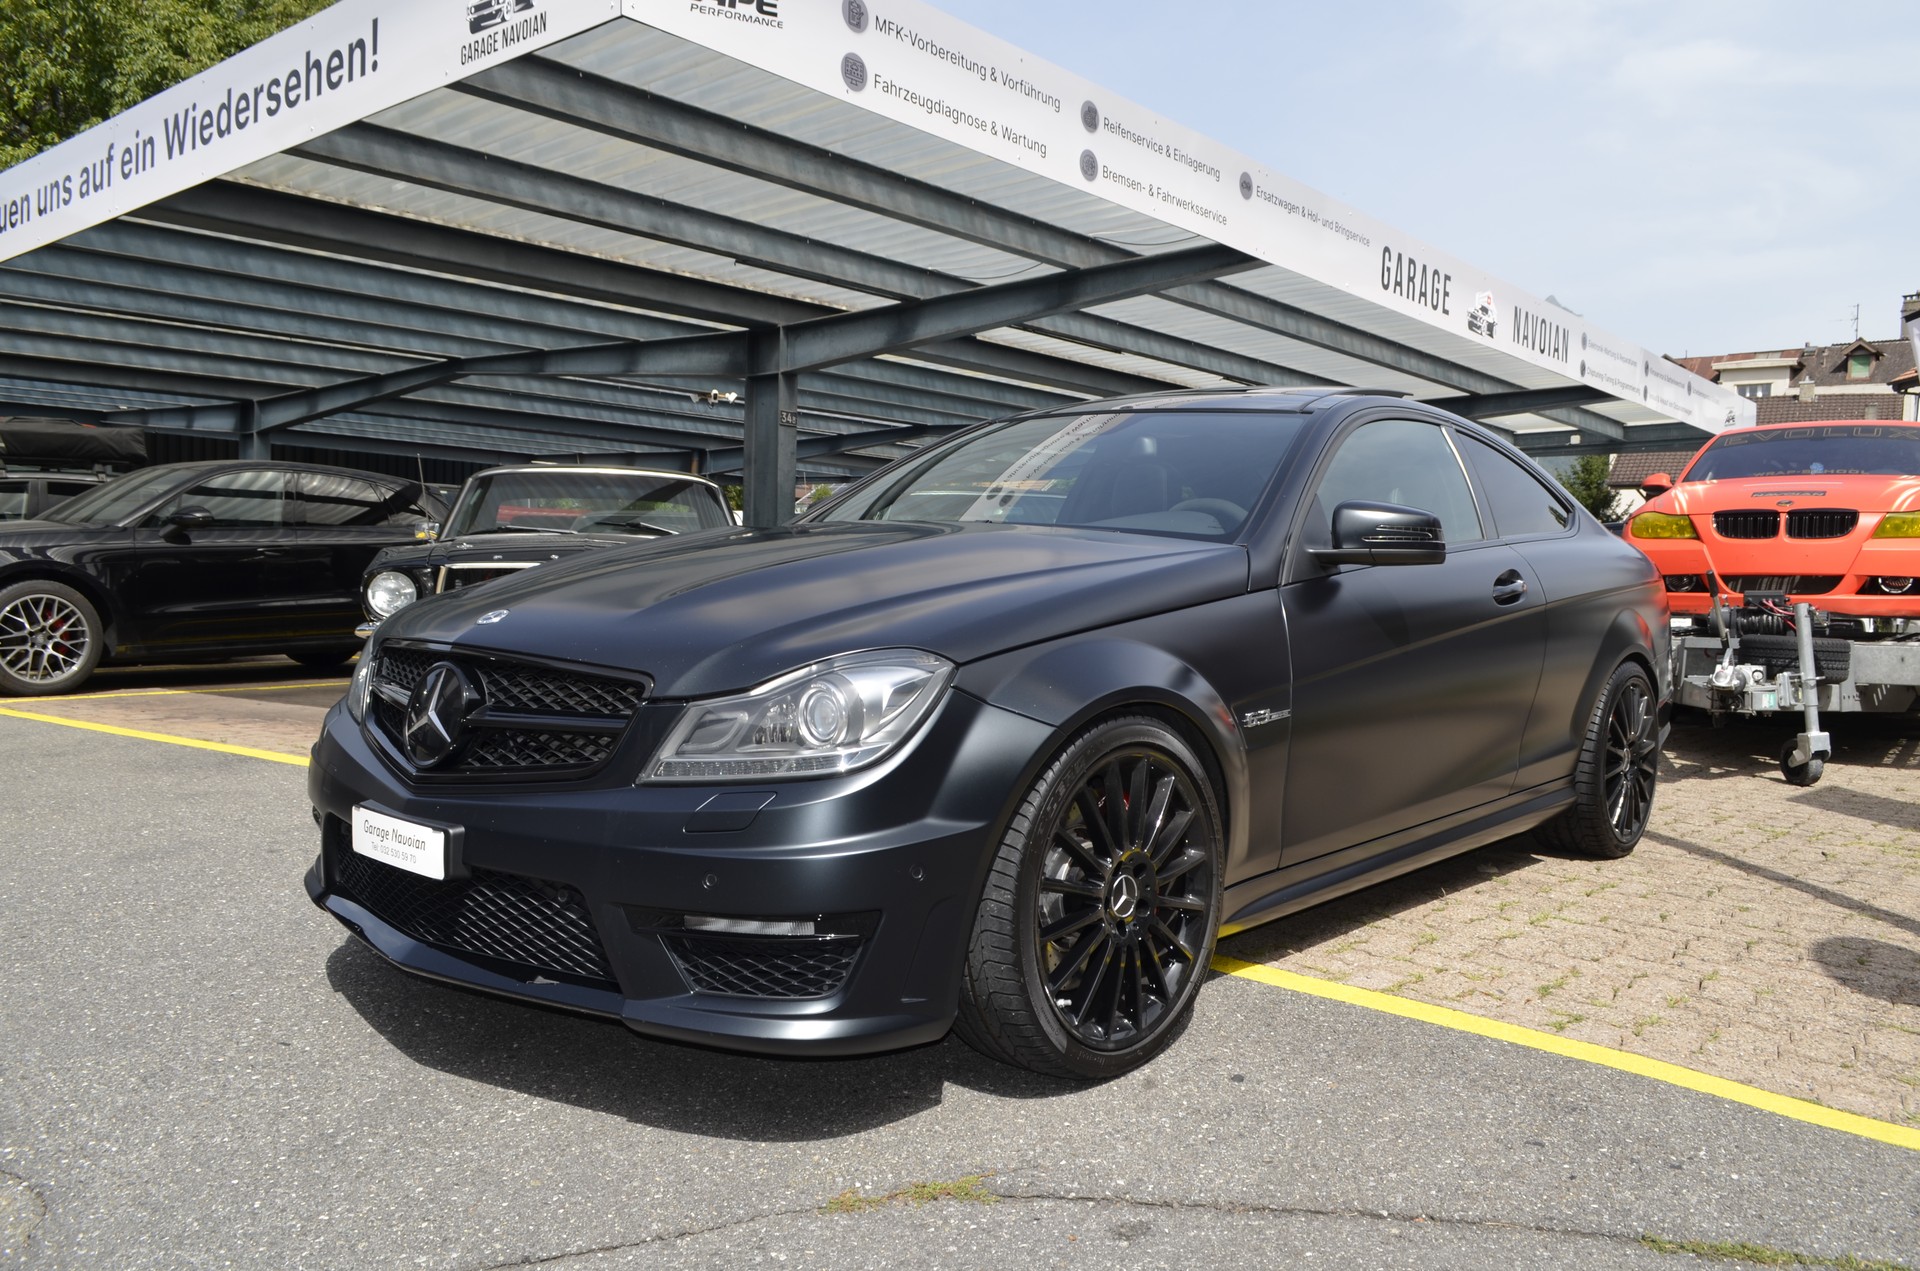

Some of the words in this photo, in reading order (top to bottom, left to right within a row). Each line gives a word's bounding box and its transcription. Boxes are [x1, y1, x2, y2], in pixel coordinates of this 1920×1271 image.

[460, 31, 499, 66] GARAGE
[501, 11, 547, 49] NAVOIAN
[689, 3, 784, 29] PERFORMANCE
[875, 15, 987, 81] MFK-Vorbereitung
[989, 66, 998, 82] &
[1001, 70, 1061, 113] Vorführung
[37, 174, 73, 217] uns
[79, 142, 115, 199] auf
[120, 129, 155, 180] ein
[163, 17, 379, 160] Wiedersehen!
[874, 73, 988, 132] Fahrzeugdiagnose
[990, 120, 998, 136] &
[1001, 124, 1047, 158] Wartung
[1103, 117, 1164, 155] Reifenservice
[1165, 145, 1171, 158] &
[1173, 148, 1220, 182] Einlagerung
[1102, 165, 1146, 192] Bremsen-
[1148, 184, 1154, 197] &
[1156, 187, 1227, 226] Fahrwerksservice
[1256, 185, 1300, 215] Ersatzwagen
[1301, 206, 1306, 218] &
[1307, 208, 1321, 224] Hol-
[1322, 217, 1334, 231] und
[1334, 221, 1370, 247] Bringservice
[1381, 245, 1452, 316] GARAGE
[1512, 305, 1570, 364] NAVOIAN
[1724, 426, 1920, 447] EVOLUX
[363, 819, 390, 844] Garage
[391, 828, 426, 851] Navoian
[380, 844, 390, 856] 032
[390, 847, 401, 859] 530
[401, 851, 409, 862] 59
[409, 854, 417, 864] 70
